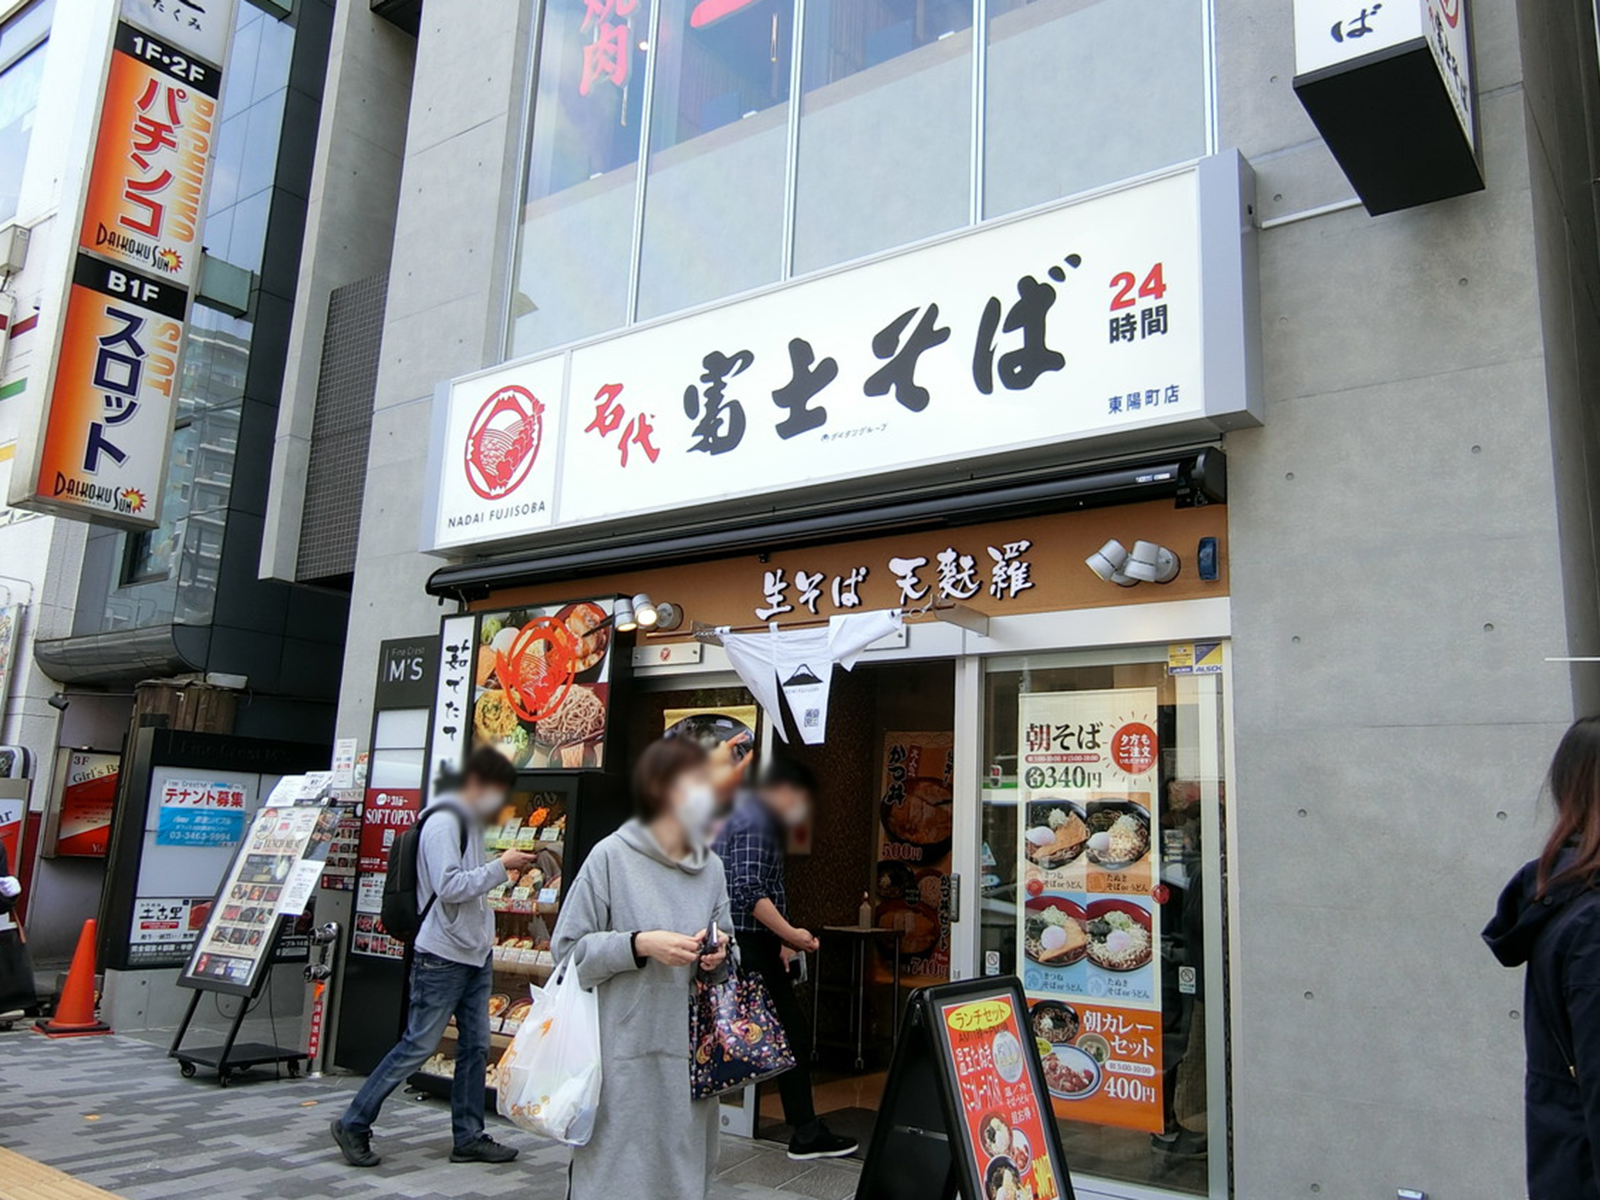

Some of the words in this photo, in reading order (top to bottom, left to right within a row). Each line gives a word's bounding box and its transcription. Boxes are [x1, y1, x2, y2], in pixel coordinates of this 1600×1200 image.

[1330, 3, 1382, 43] ば
[119, 78, 187, 238] パチンコ
[167, 96, 216, 244] PACHINKO
[96, 222, 151, 260] DAIKOKU
[107, 269, 160, 303] B1F
[1109, 263, 1167, 311] 24
[1109, 304, 1168, 344] 時間
[683, 253, 1082, 456] 富士そば
[83, 306, 146, 473] スロット
[1107, 384, 1180, 414] 東陽町店
[584, 383, 660, 468] 名代
[54, 471, 112, 504] DAIKOKU
[448, 512, 484, 528] NADAI
[489, 500, 545, 521] FUJISOBA
[756, 565, 868, 621] 生そば
[389, 657, 424, 682] M'S
[1026, 721, 1104, 752] 朝そば
[1120, 734, 1151, 745] 夕方も
[73, 756, 89, 766] 3F
[1119, 746, 1151, 757] ご注文
[73, 767, 103, 783] Girl's
[165, 788, 244, 808] テナント募集
[365, 808, 390, 824] SOFT
[882, 843, 922, 861] 500円
[1106, 883, 1149, 893] そばorうどん
[1043, 981, 1083, 992] そばorうどん
[1107, 988, 1150, 999] そばorうどん
[955, 1004, 1006, 1029] ランチセット
[1083, 1010, 1154, 1034] 朝カレー
[1110, 1035, 1154, 1058] セット
[1103, 1077, 1156, 1103] 400円
